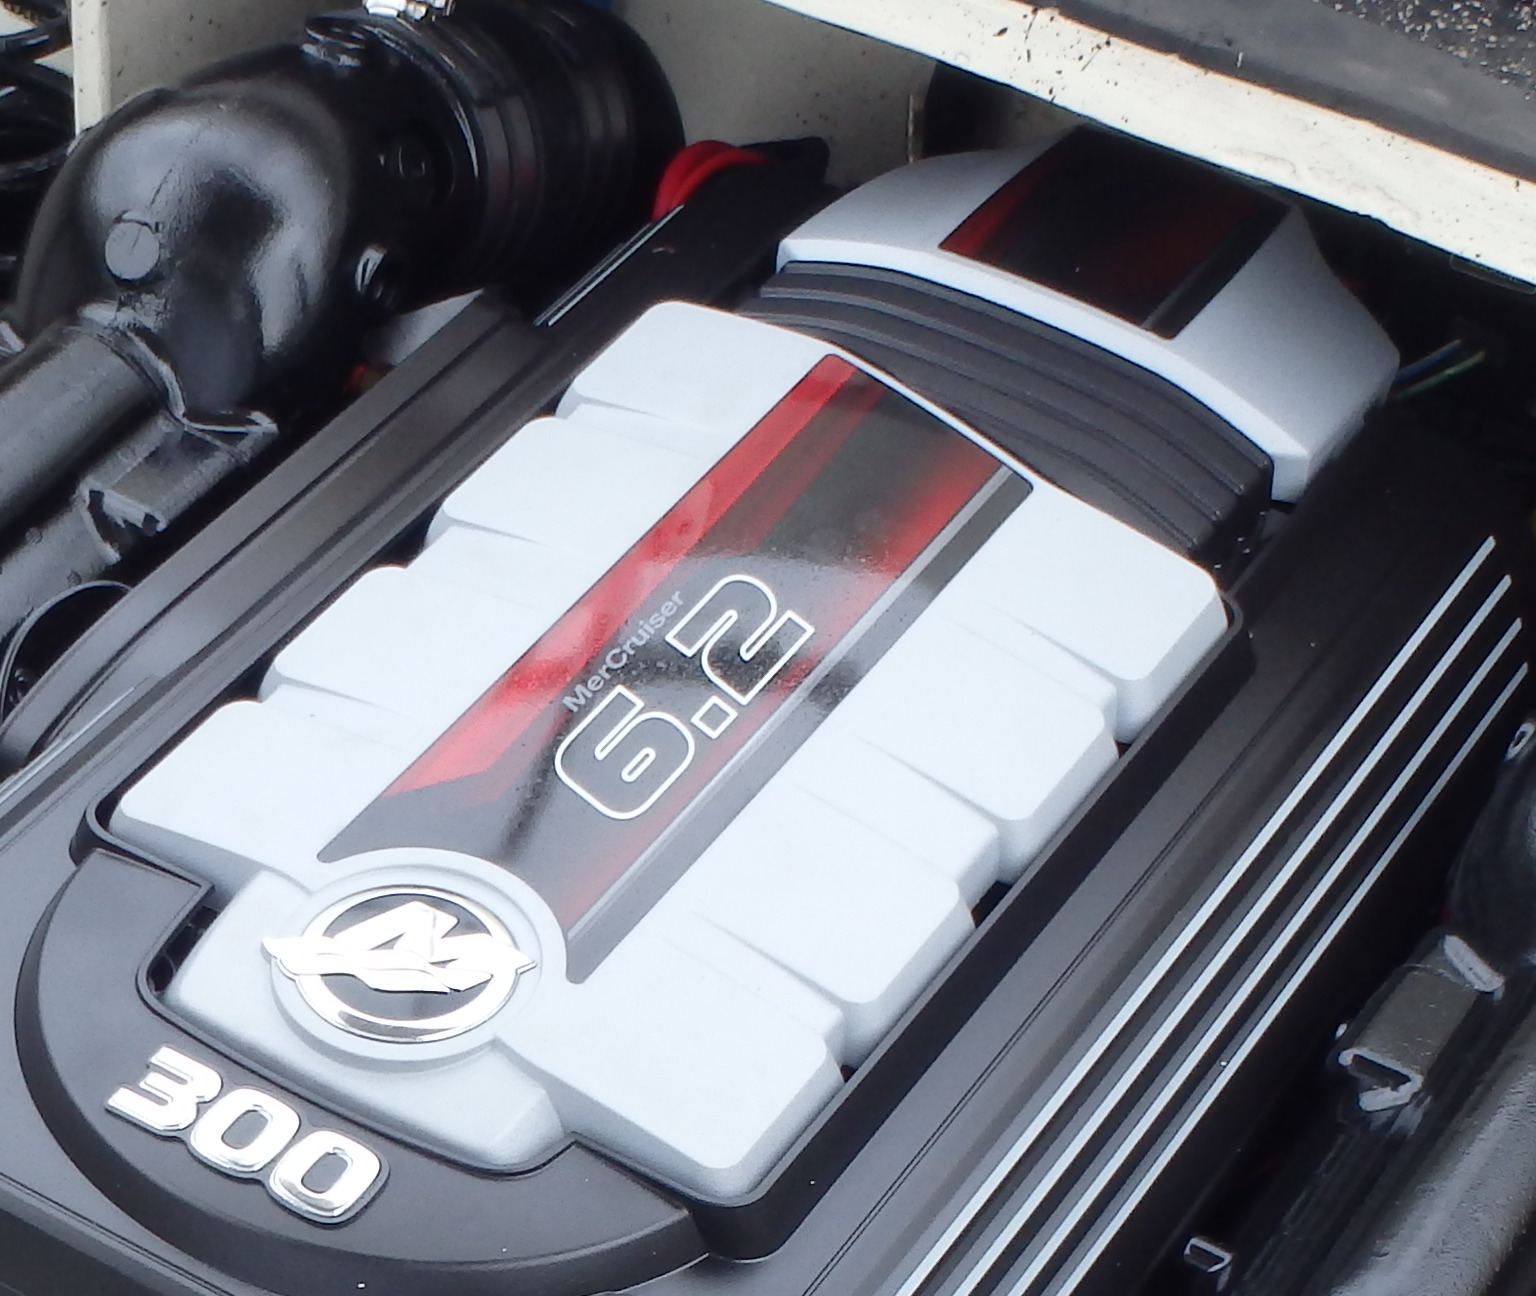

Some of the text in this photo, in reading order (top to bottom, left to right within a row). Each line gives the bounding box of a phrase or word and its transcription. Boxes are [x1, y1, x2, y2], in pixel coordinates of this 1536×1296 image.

[554, 574, 816, 820] 6.2
[562, 590, 686, 713] MerCruiser
[104, 1046, 390, 1224] 300
